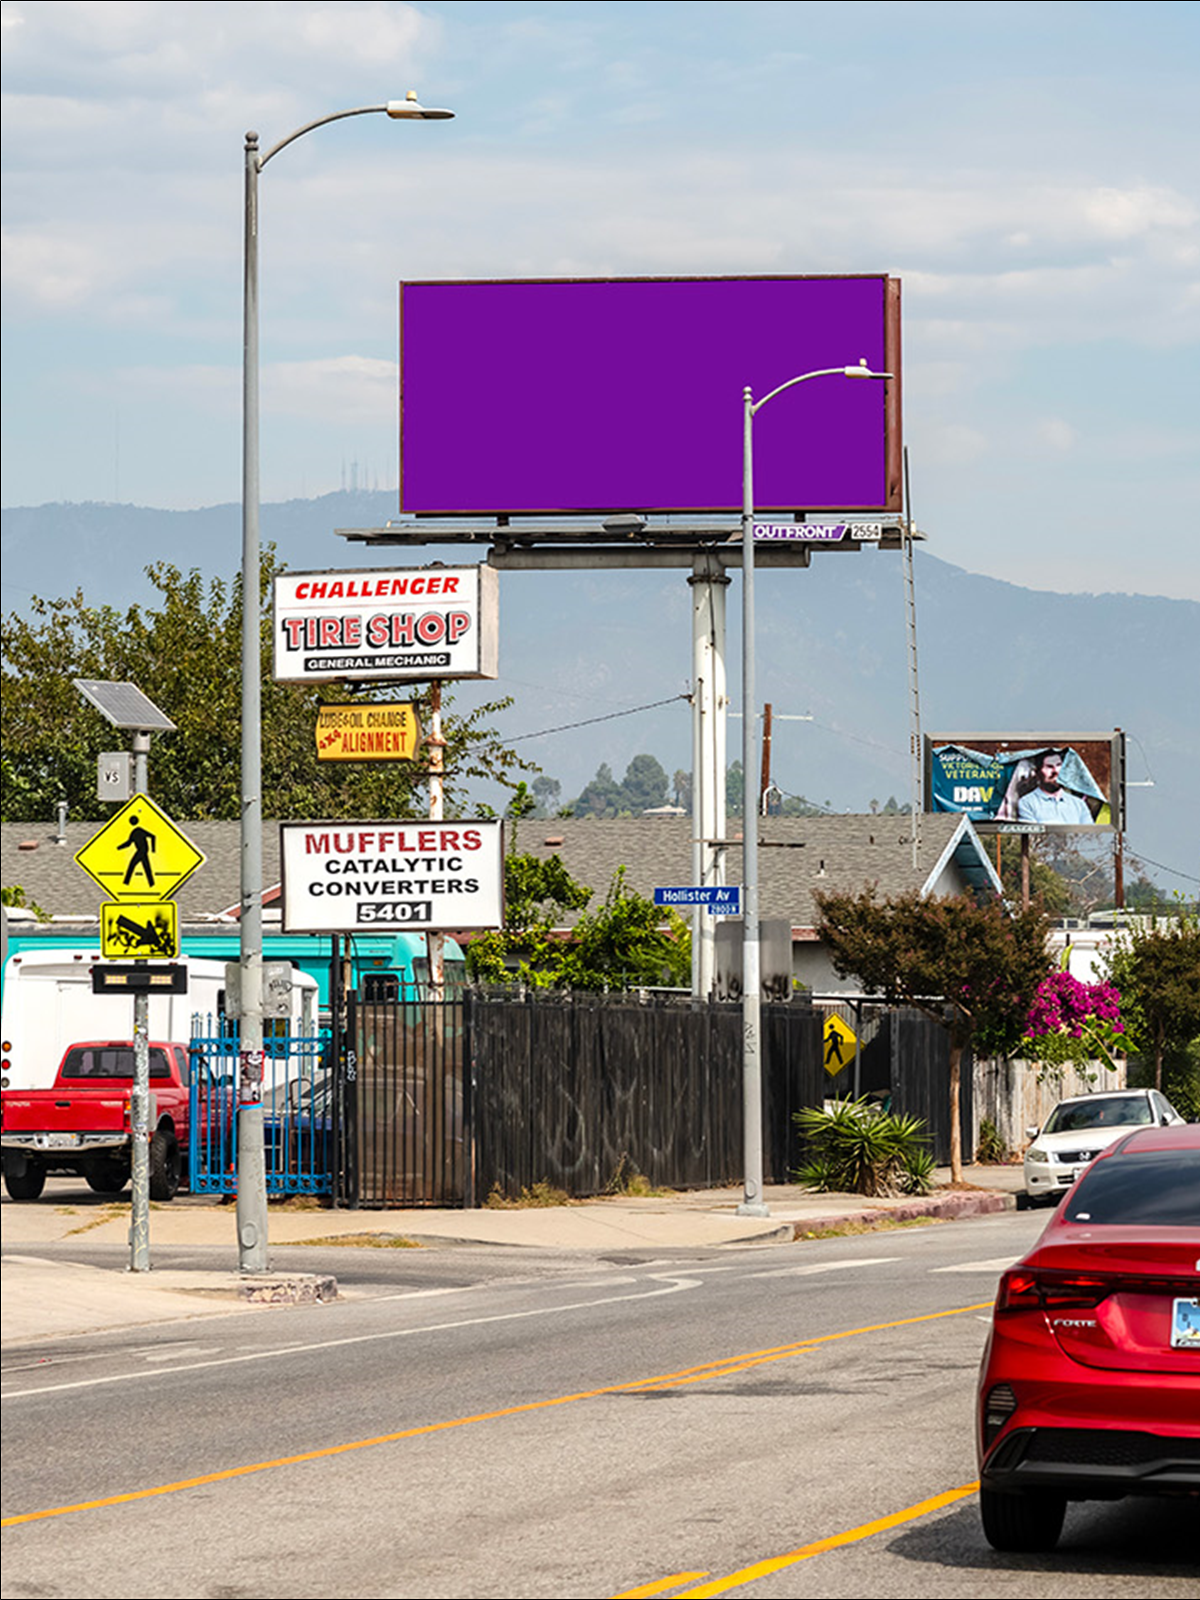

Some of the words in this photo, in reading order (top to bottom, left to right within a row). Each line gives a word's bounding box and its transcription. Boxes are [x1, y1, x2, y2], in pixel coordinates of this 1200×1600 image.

[754, 526, 837, 538] OUTFRONT
[295, 577, 460, 600] CHALLENGER
[282, 615, 362, 651] TIRE
[366, 611, 471, 648] SHOP
[307, 657, 374, 670] GENERAL
[375, 654, 447, 667] MECHANIC
[366, 711, 407, 728] CHANGE
[341, 732, 407, 753] ALIGNMENT
[945, 770, 1001, 780] VETERANS
[954, 786, 994, 803] DAV
[305, 829, 483, 854] MUFFLERS
[325, 857, 463, 875] CATALYTIC
[308, 878, 480, 897] CONVERTERS
[663, 890, 711, 902] Hollister
[715, 889, 731, 902] Av
[359, 903, 428, 921] 5401
[1053, 1318, 1097, 1328] FORTE
